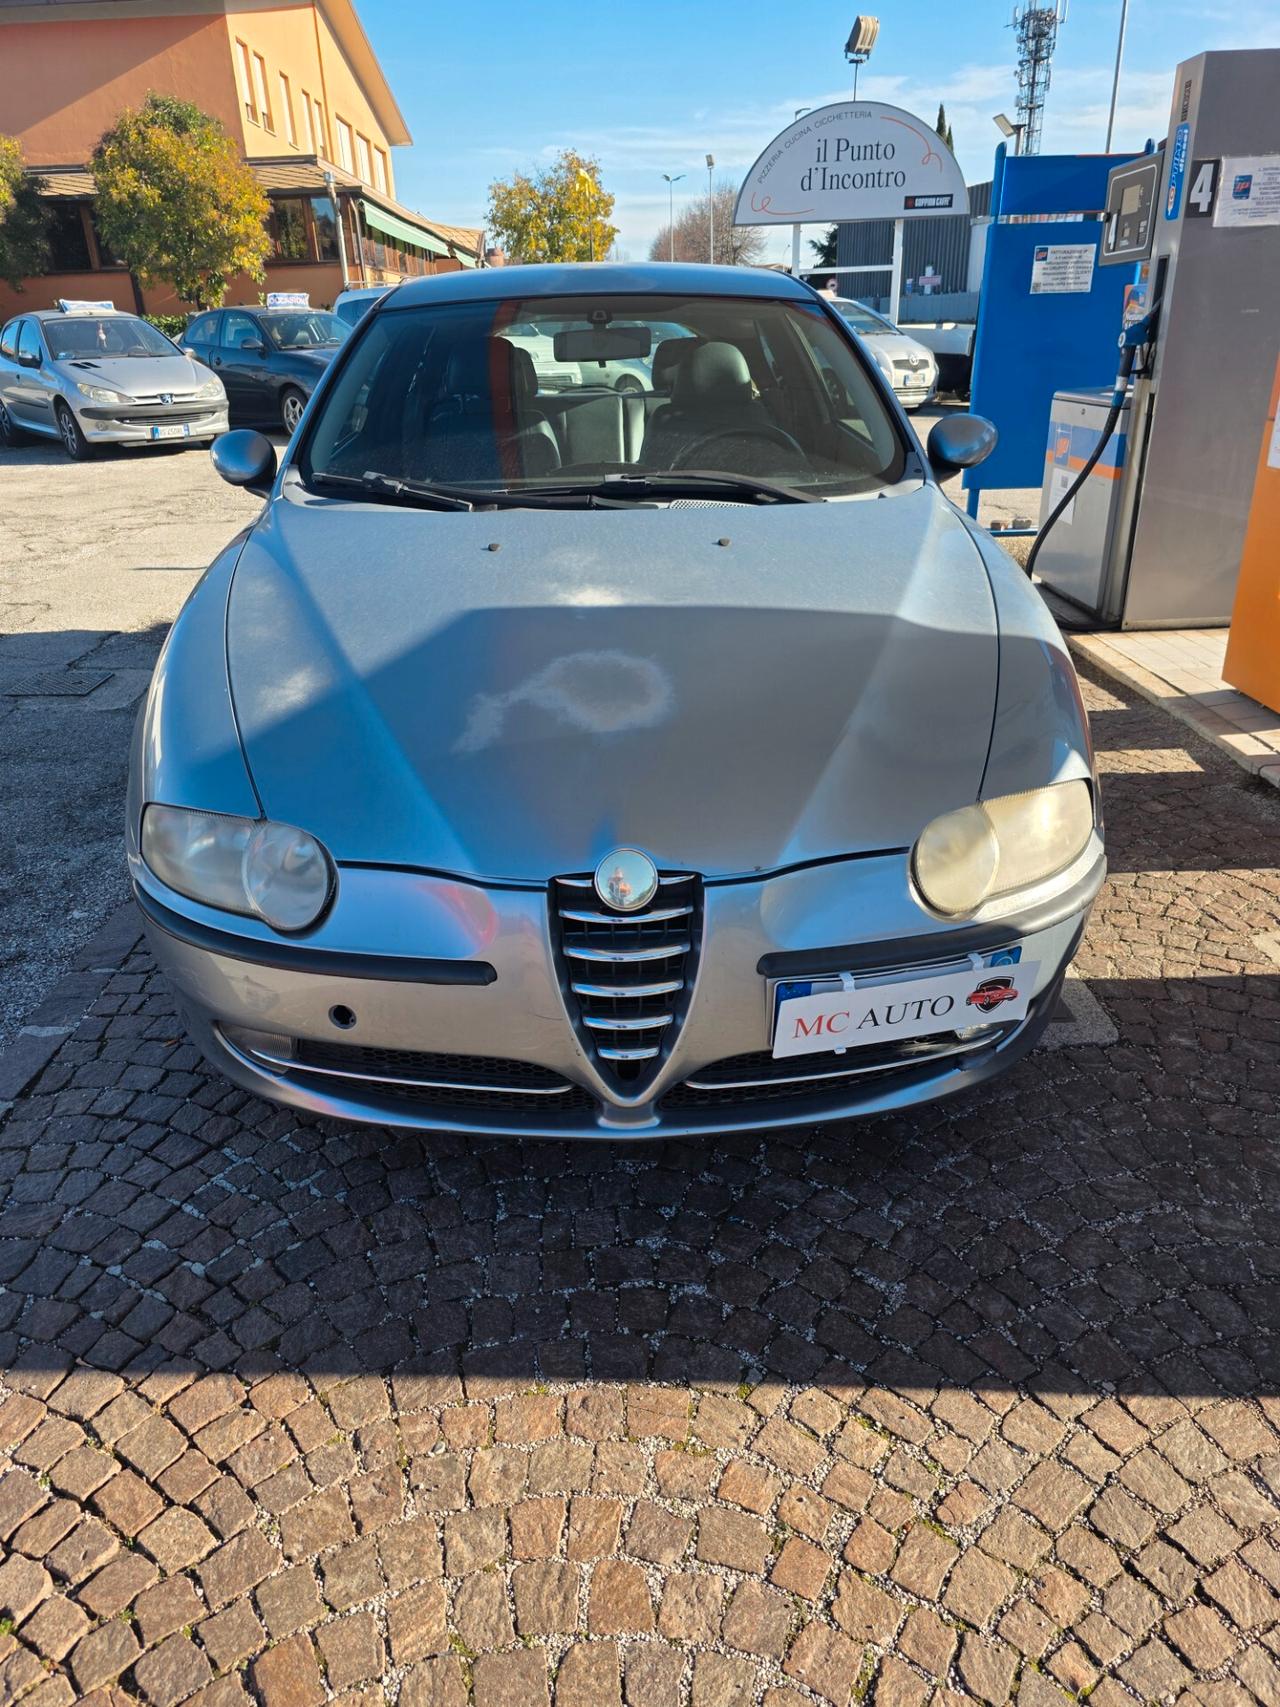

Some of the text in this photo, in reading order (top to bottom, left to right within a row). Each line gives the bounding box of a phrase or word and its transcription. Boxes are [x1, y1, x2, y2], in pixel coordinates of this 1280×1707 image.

[757, 110, 873, 184] PIZZERIA CUCINA CICCHETTERIA
[816, 138, 896, 163] il Punto
[1189, 163, 1215, 213] 4
[1108, 213, 1118, 250] 4
[792, 995, 955, 1039] MC AUTO
